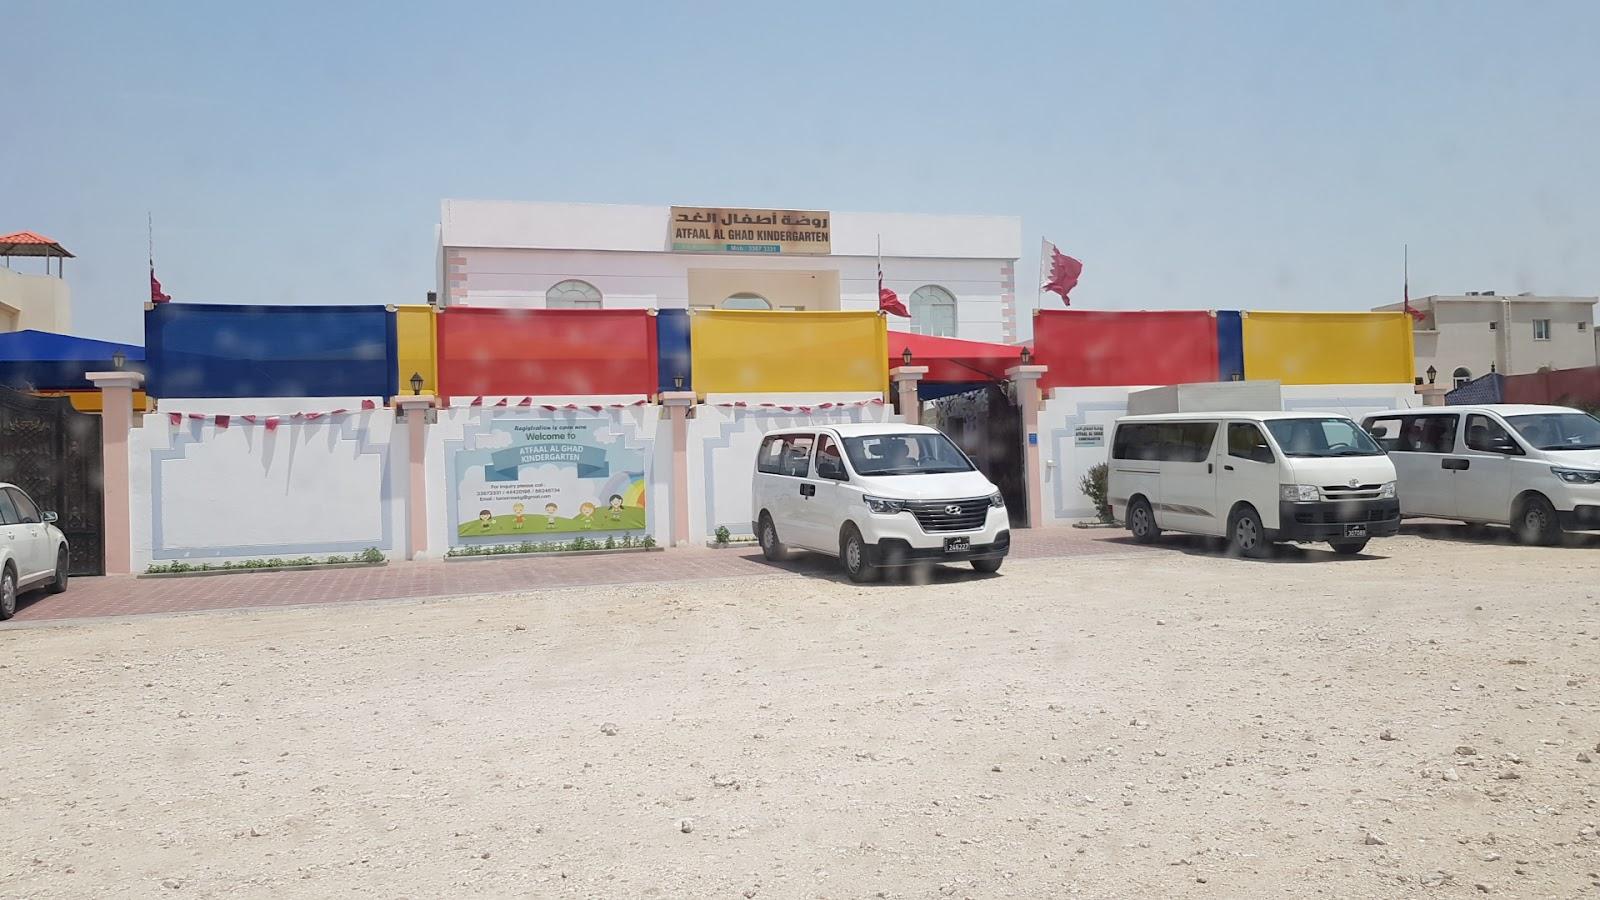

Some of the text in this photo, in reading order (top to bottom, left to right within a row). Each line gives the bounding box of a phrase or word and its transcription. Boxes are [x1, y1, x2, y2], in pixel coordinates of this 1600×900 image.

[675, 212, 828, 229] روضة أطفال الغد
[675, 228, 829, 242] ATFAAL AL GHAD KINDERGARTEN
[526, 432, 576, 441] Welcome to
[519, 444, 584, 455] ATFAAL AL GHAD
[521, 453, 580, 462] KINDERGARTEN
